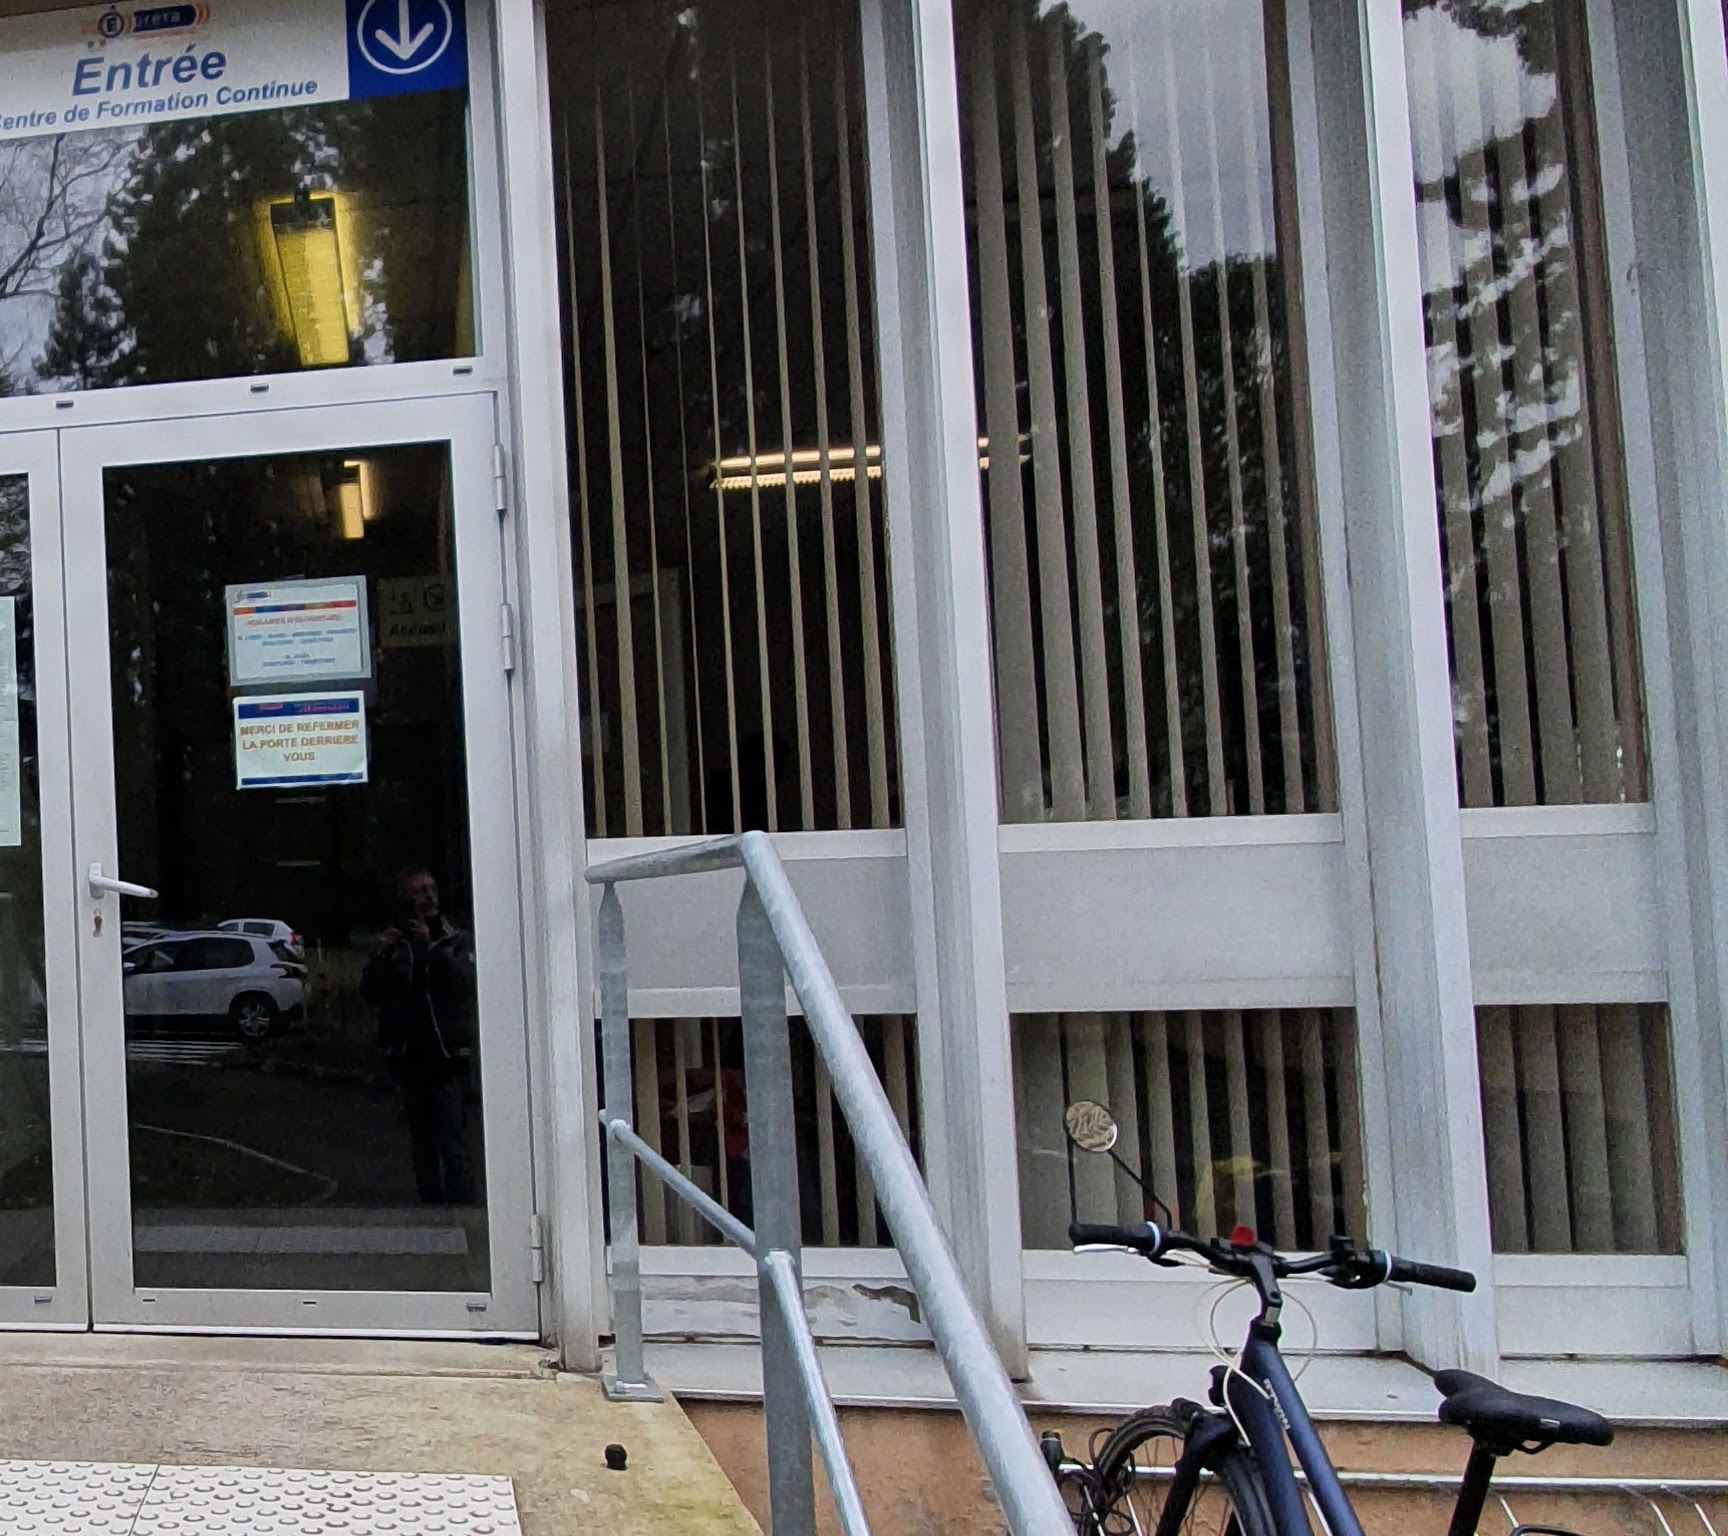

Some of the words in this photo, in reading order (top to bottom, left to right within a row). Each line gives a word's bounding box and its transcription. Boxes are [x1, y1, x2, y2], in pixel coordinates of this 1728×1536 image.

[73, 43, 227, 97] Entrée
[63, 104, 90, 123] de
[97, 93, 209, 119] Formation
[216, 80, 319, 106] Continue
[239, 724, 276, 736] MERCI
[278, 723, 294, 734] DE
[297, 719, 359, 732] REFERMER
[242, 740, 257, 750] LA
[260, 737, 298, 749] PORTE
[283, 751, 316, 762] VOUS
